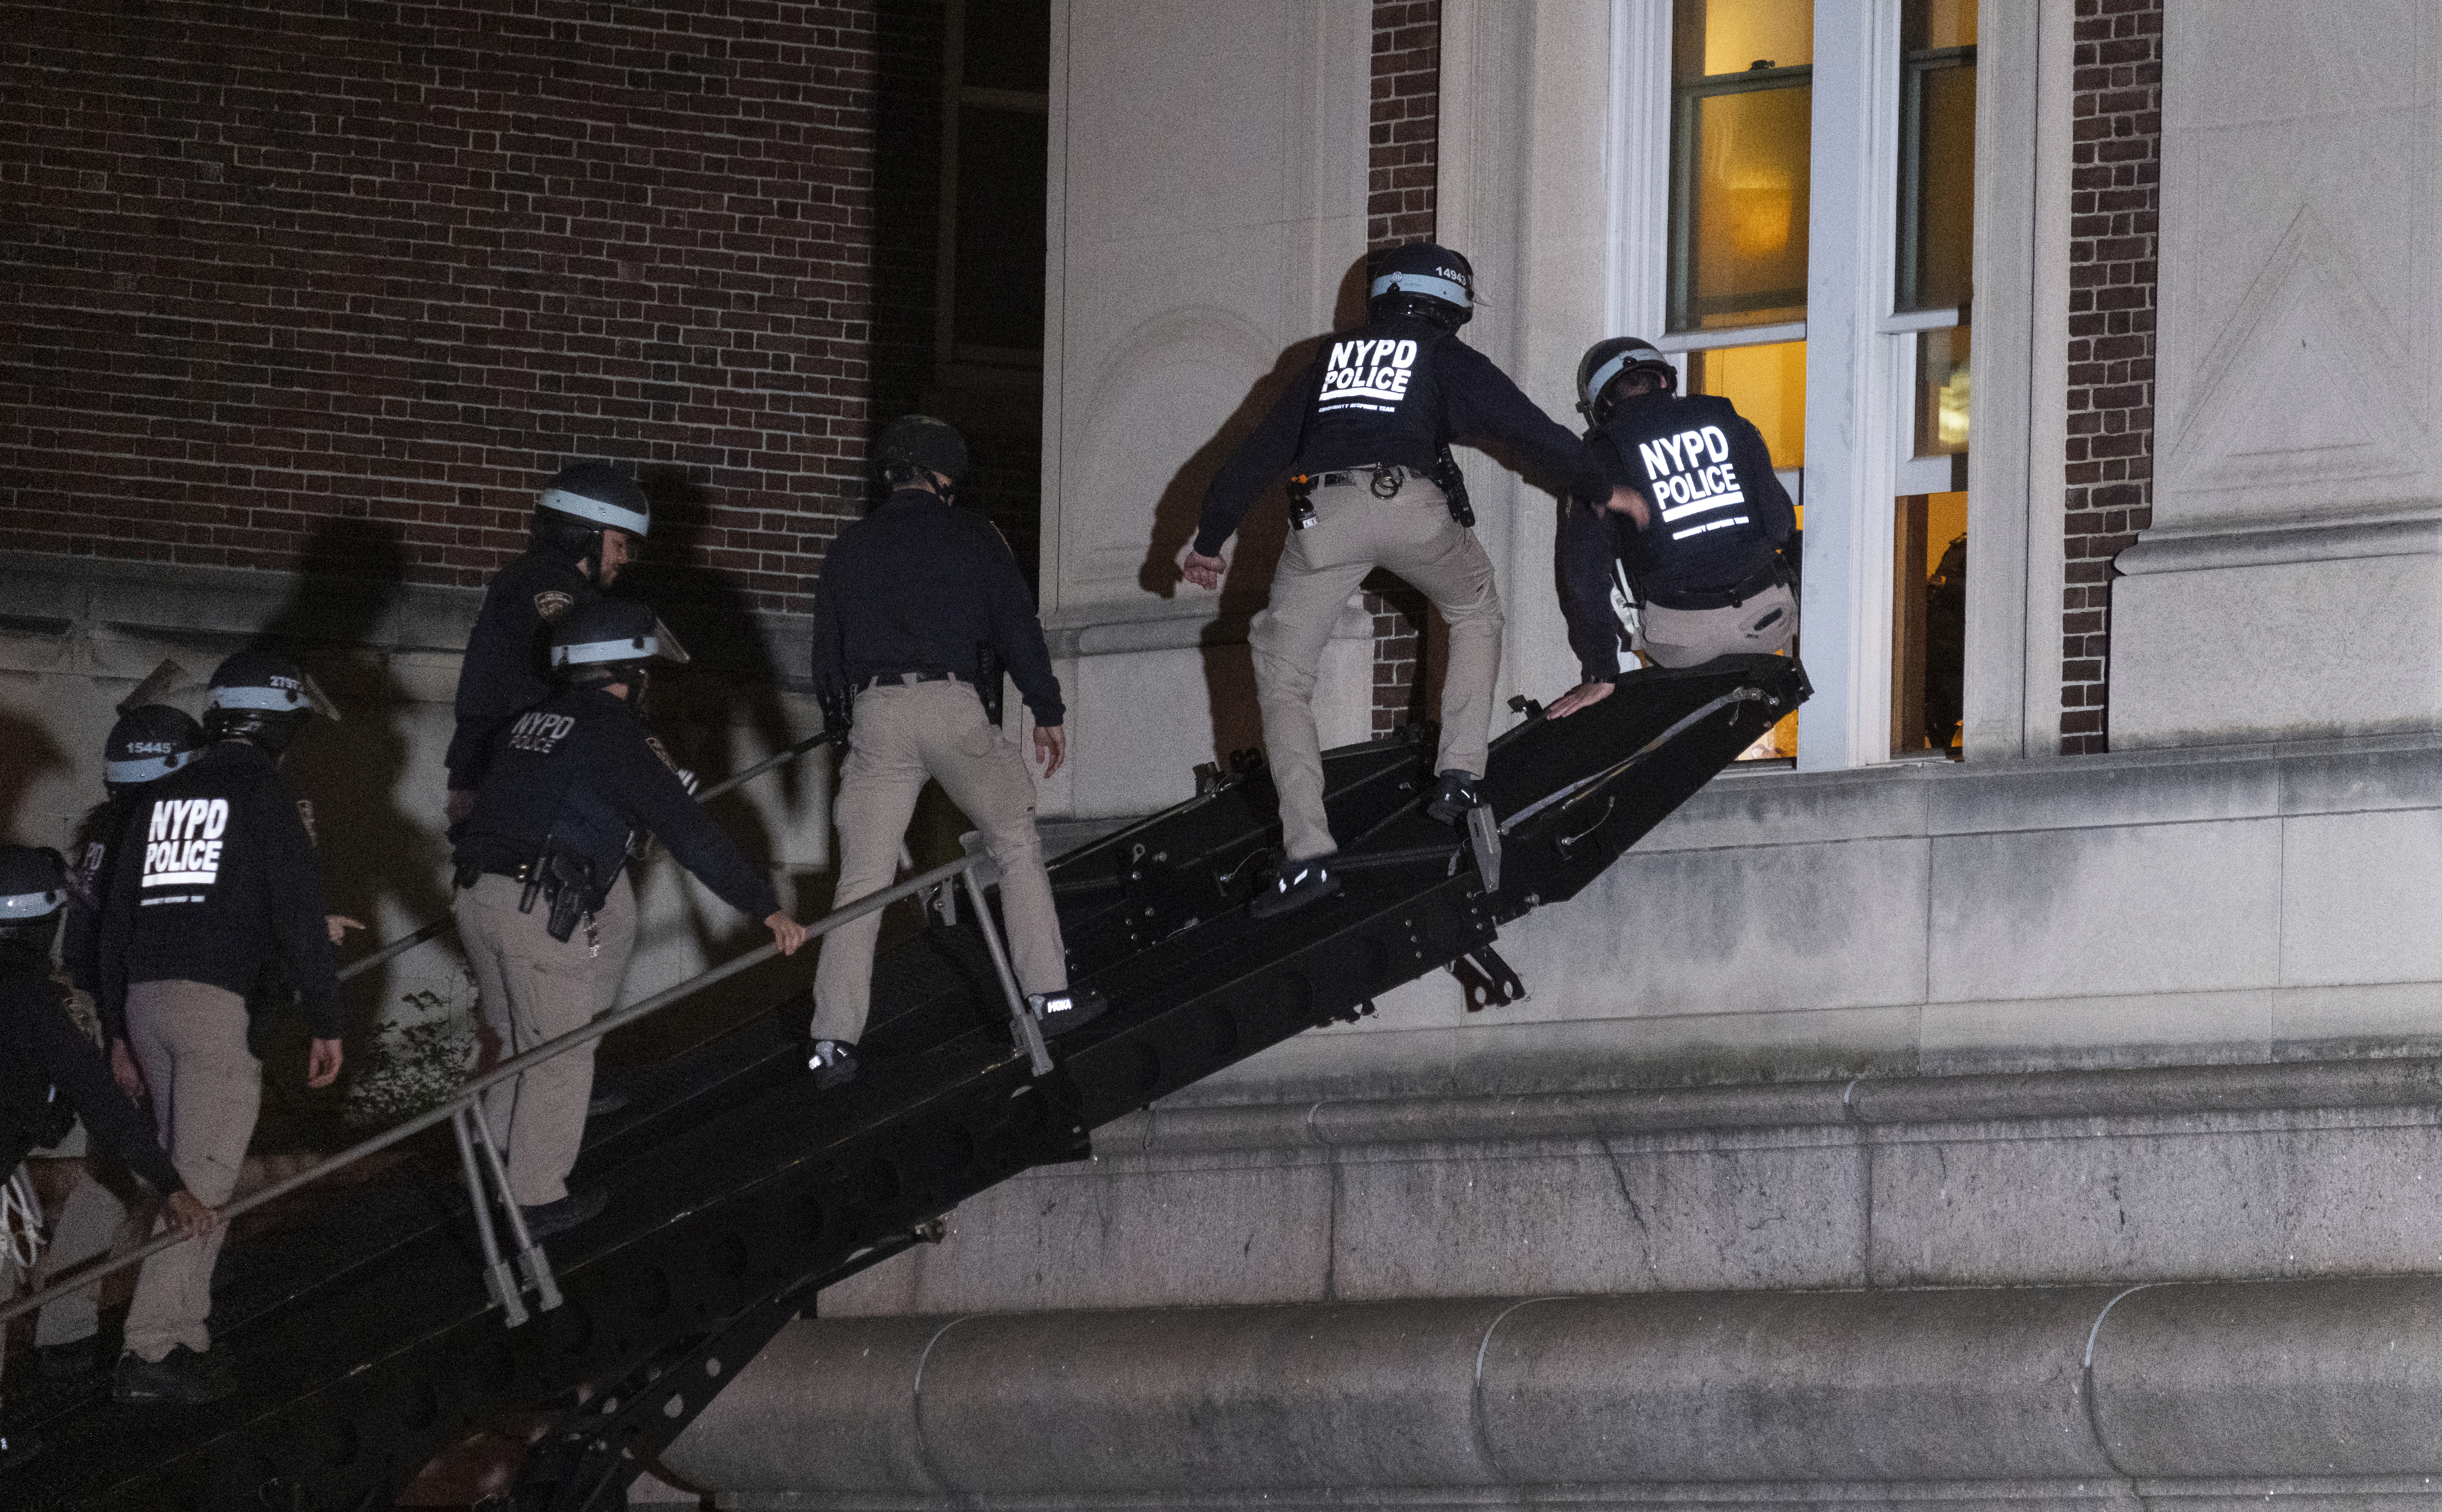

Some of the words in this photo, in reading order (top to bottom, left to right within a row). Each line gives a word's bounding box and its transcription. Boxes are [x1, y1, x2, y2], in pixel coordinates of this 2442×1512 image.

[1435, 266, 1467, 286] 14943
[1327, 339, 1418, 372] NYPD
[1321, 366, 1412, 393] POLICE
[1639, 426, 1729, 480] NYPD
[1652, 463, 1741, 510] POLICE
[511, 712, 575, 739] NYPD
[127, 742, 172, 754] 15445
[148, 798, 229, 842] NYPD
[143, 840, 223, 874] POLICE
[1047, 998, 1072, 1013] HOKA
